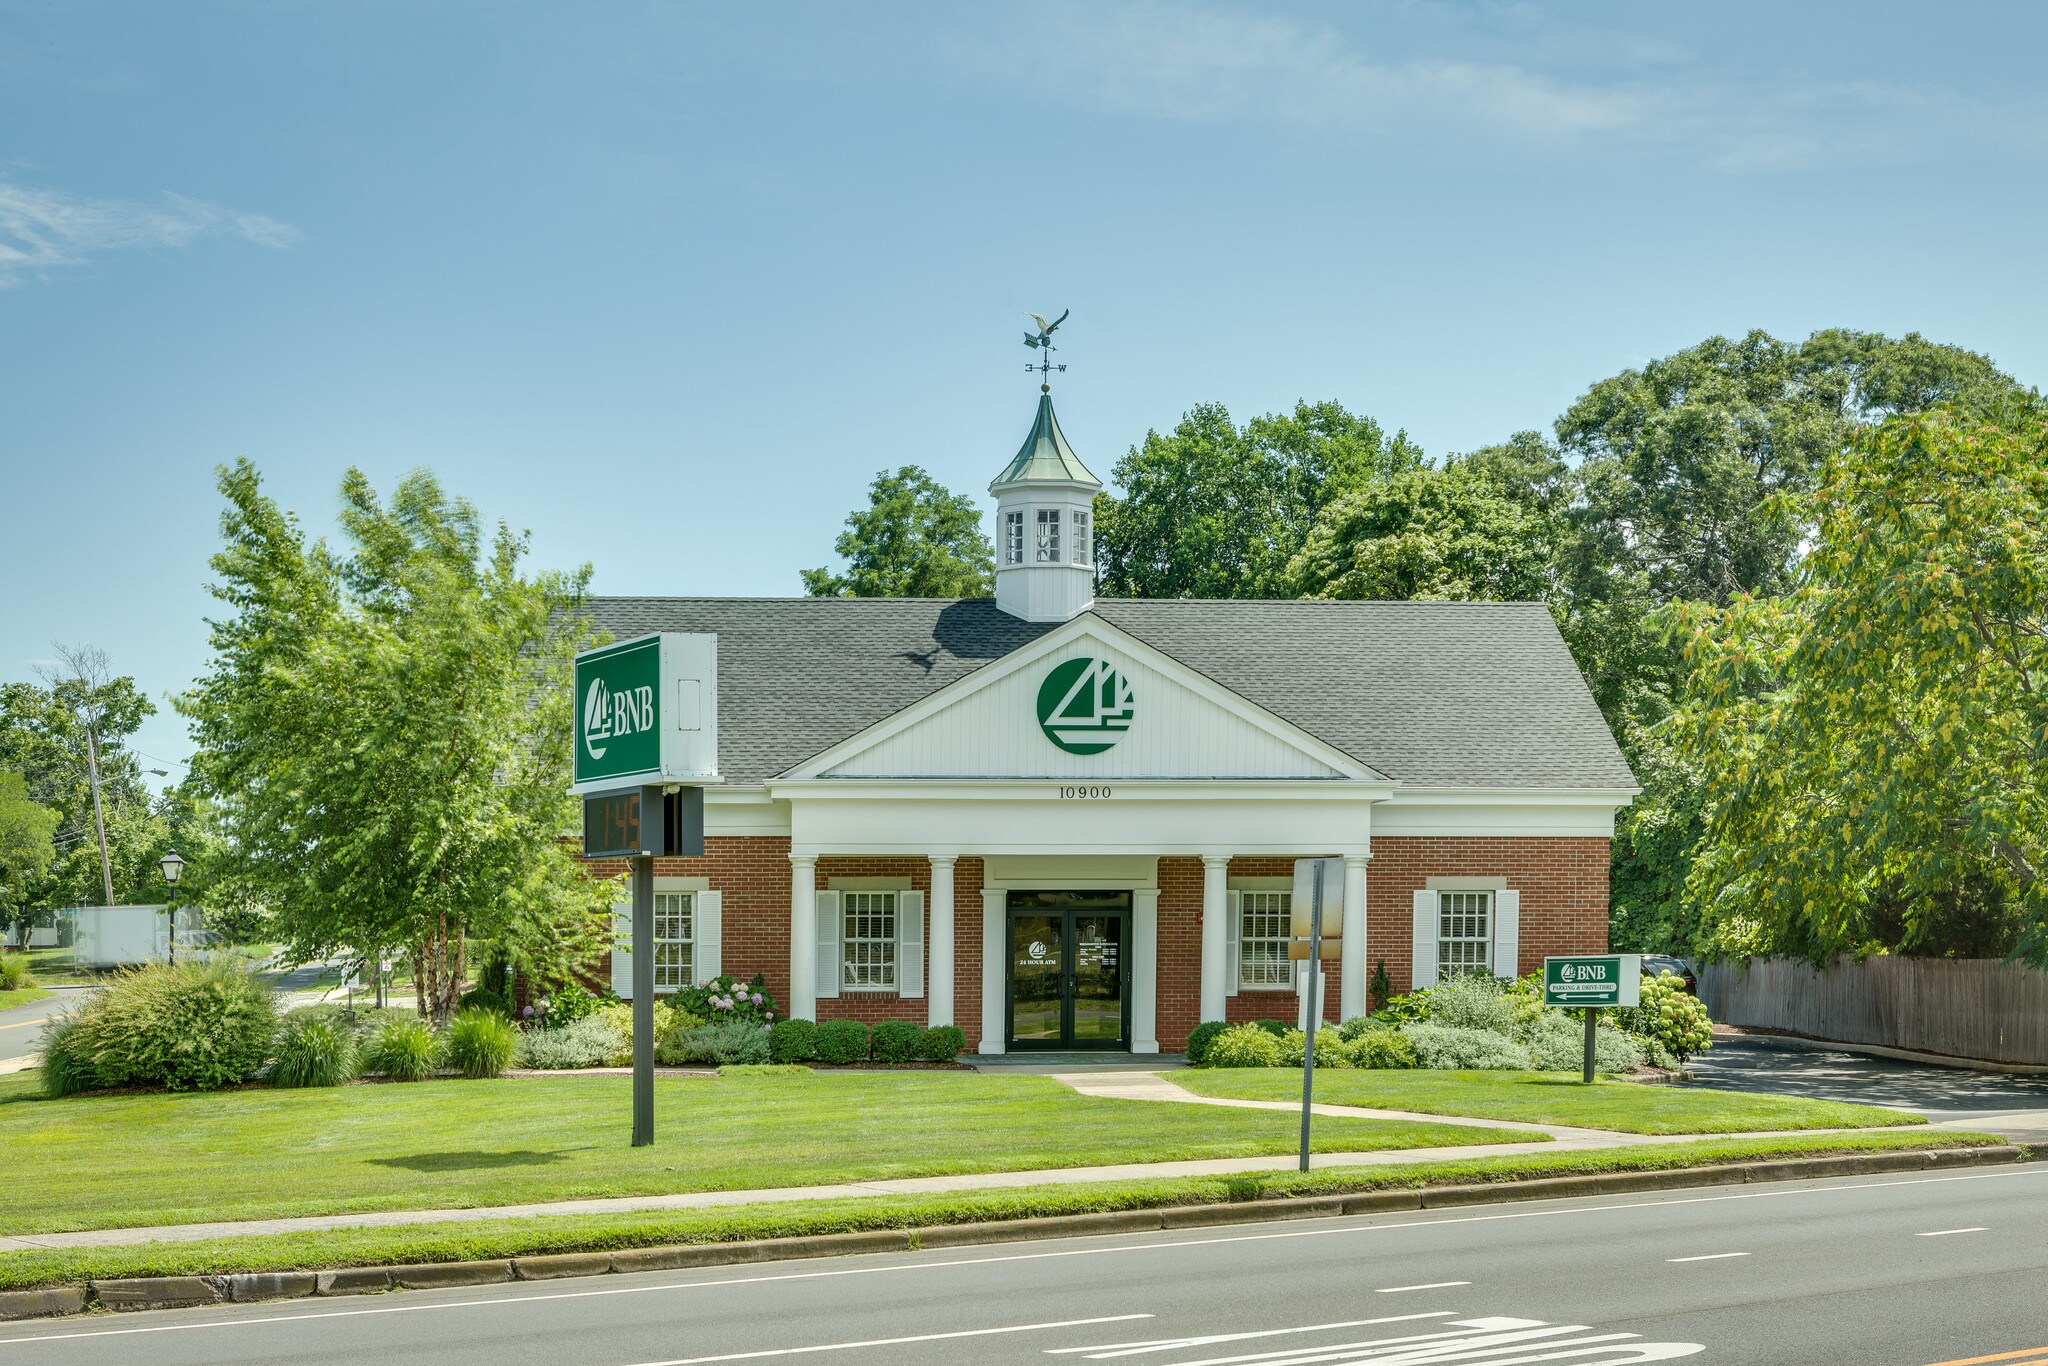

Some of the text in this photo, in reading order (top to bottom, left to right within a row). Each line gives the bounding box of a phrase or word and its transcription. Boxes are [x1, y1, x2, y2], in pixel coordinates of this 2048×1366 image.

[613, 685, 654, 737] BNB
[1060, 786, 1111, 798] 10900
[1577, 965, 1606, 980] BNB
